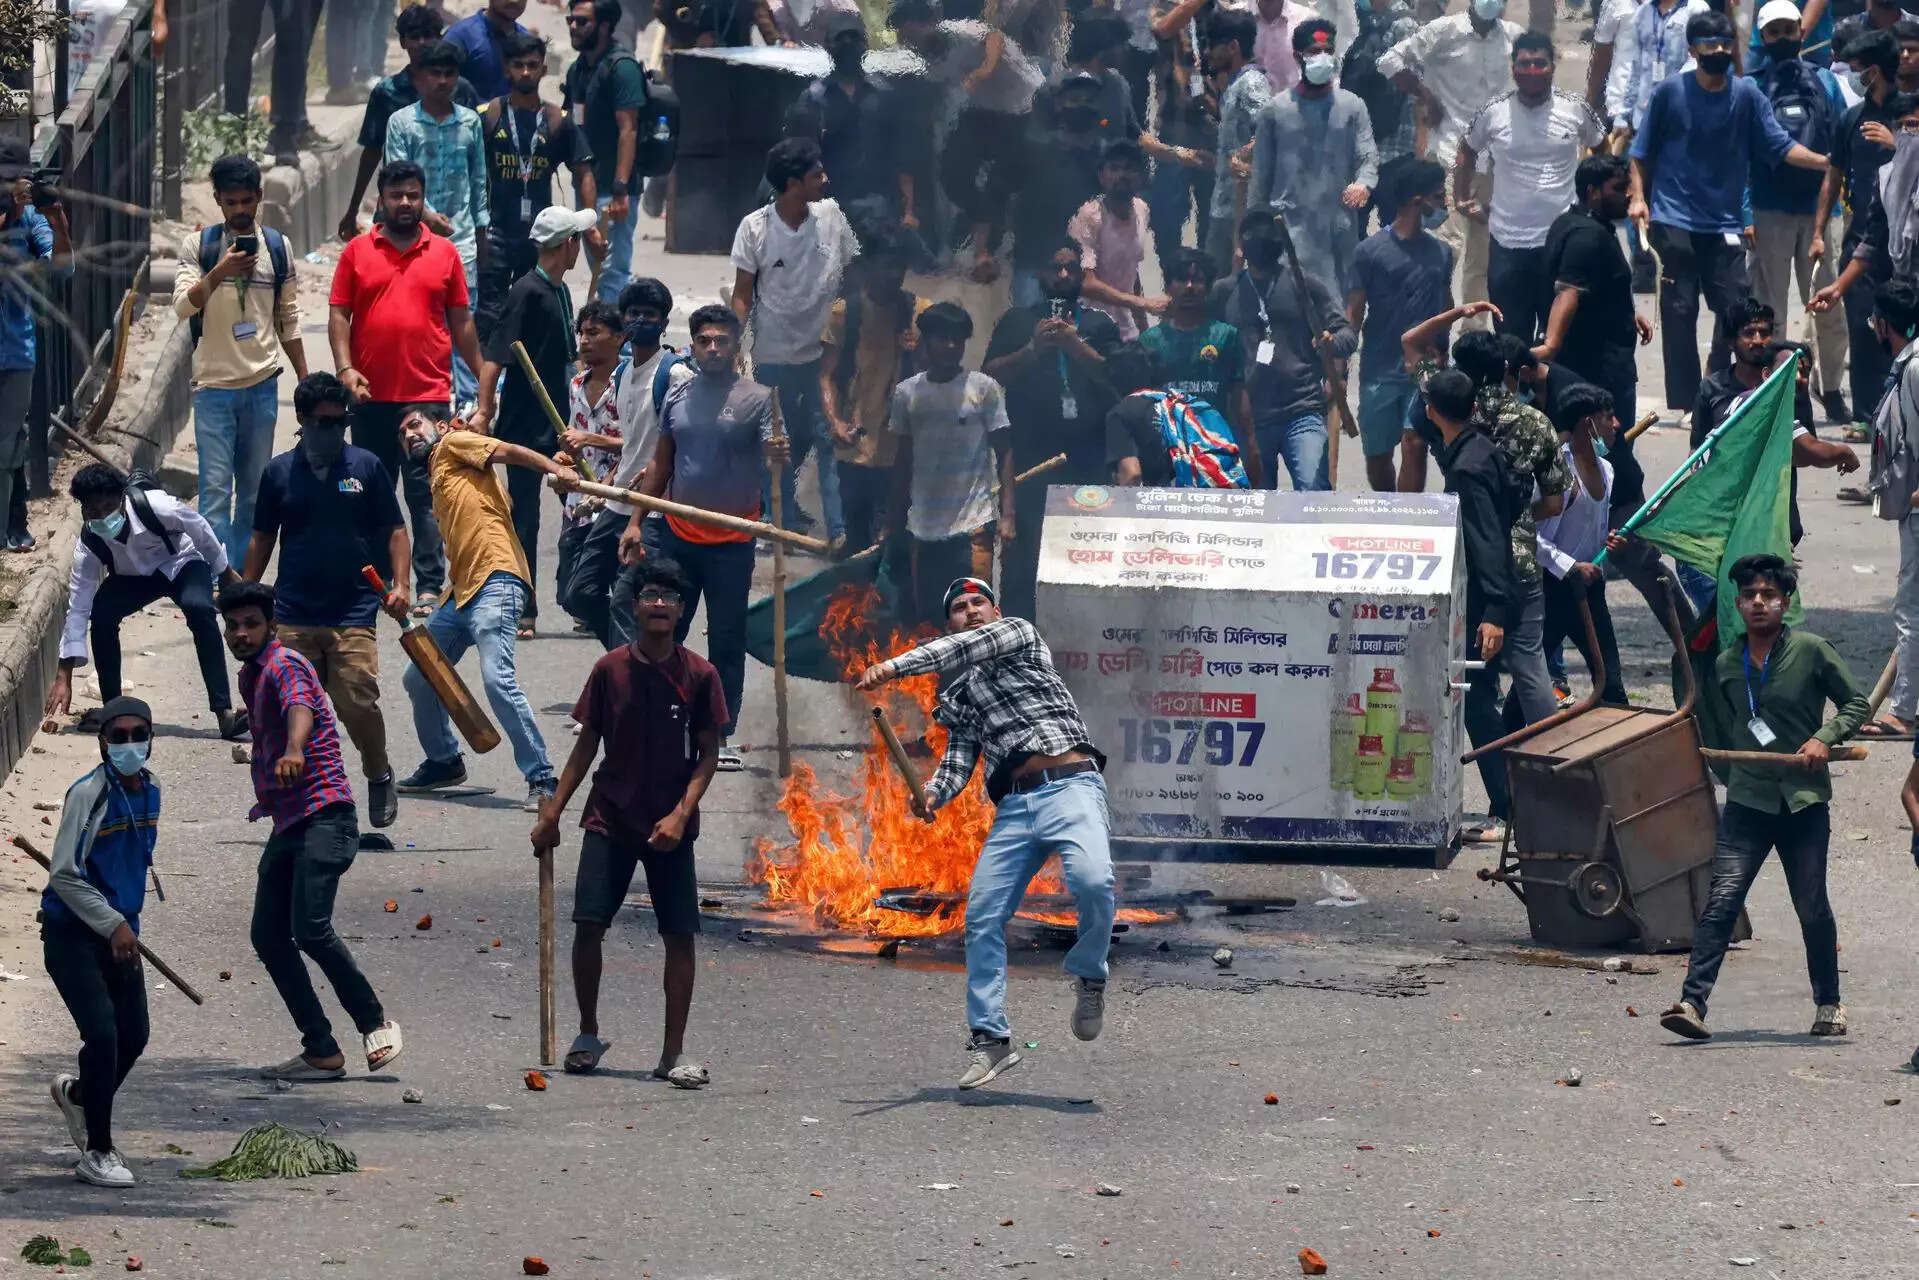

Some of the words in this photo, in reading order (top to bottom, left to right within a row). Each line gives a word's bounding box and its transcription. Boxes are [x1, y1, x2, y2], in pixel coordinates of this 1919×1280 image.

[1124, 530, 1191, 545] এলপিজি
[1197, 533, 1264, 548] সিলিন্ডার
[1347, 539, 1423, 551] HOTLINE
[1068, 549, 1114, 565] হোম
[1122, 547, 1225, 568] ডেলিভারি
[1228, 557, 1266, 569] পেতে
[1312, 552, 1442, 581] 16797
[1118, 569, 1150, 581] কল
[1223, 627, 1288, 648] সিলিন্ডার
[1207, 661, 1243, 677] পেতে
[1248, 662, 1280, 676] কল
[1118, 718, 1266, 767] 16797
[1237, 791, 1264, 802] ৯০০
